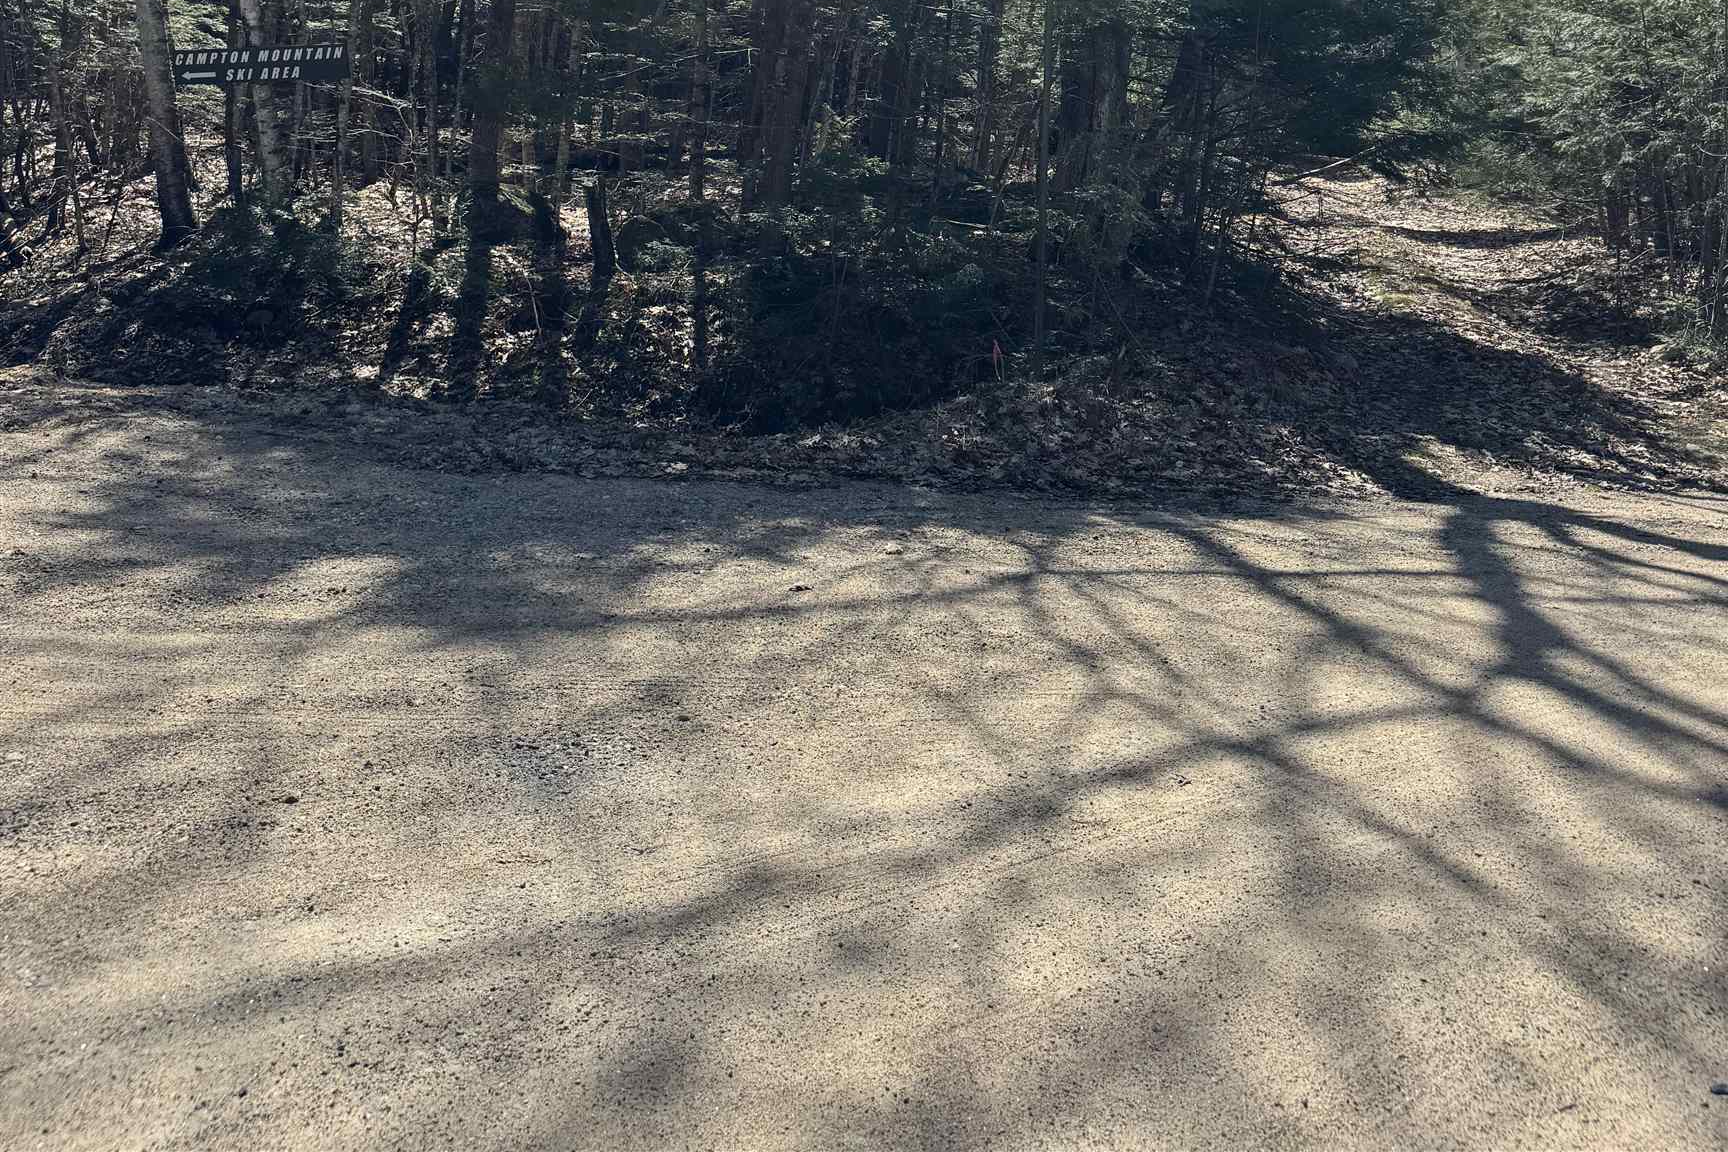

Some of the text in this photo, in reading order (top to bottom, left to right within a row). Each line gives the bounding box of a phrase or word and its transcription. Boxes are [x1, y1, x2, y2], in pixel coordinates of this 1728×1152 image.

[175, 46, 343, 66] CAMPTON MOUNTAIN
[226, 66, 300, 81] SKI AREA
